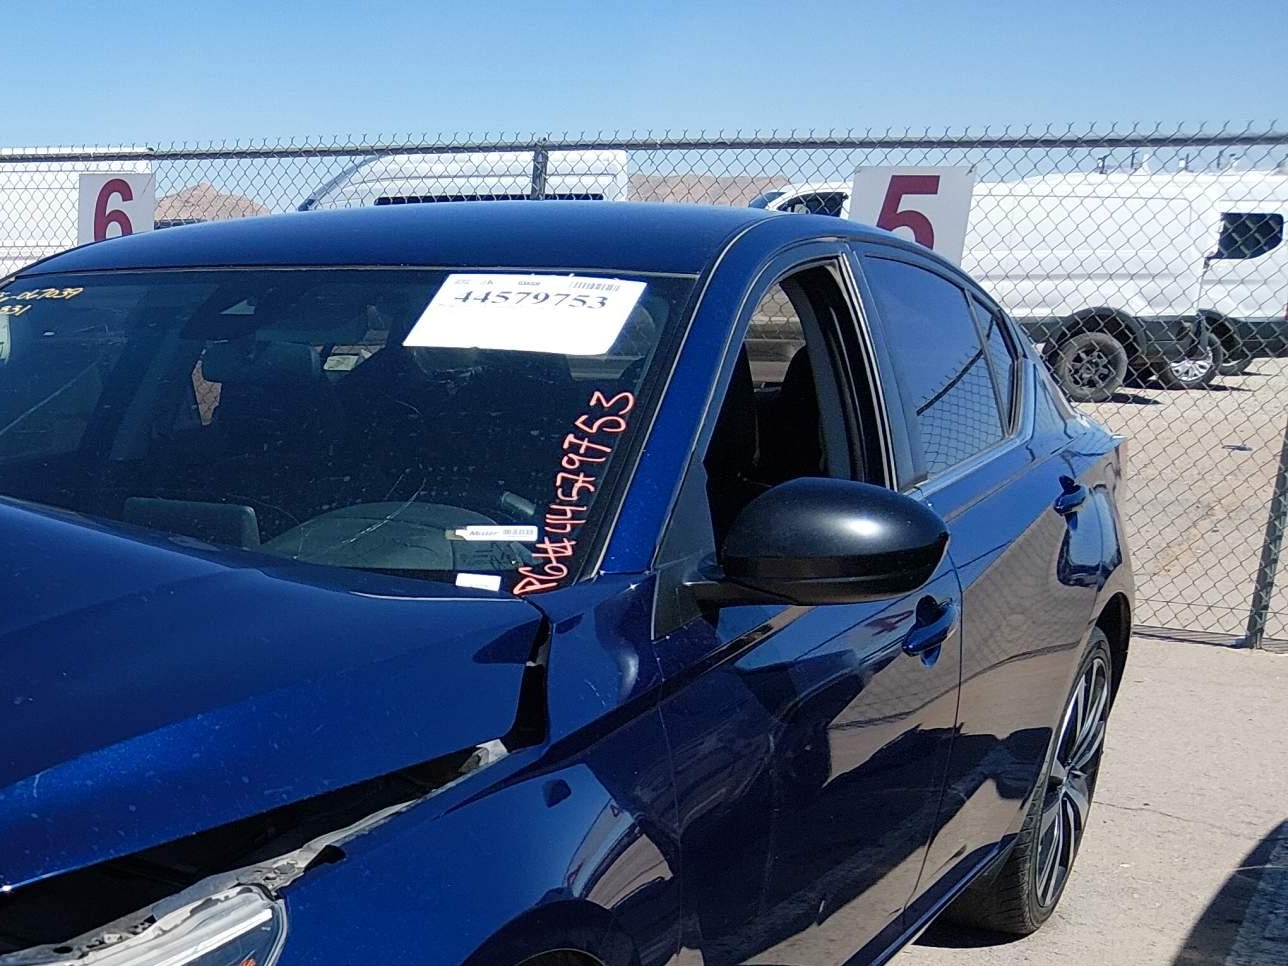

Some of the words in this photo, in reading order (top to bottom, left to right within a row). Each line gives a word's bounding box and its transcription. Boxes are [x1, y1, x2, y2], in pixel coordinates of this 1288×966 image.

[94, 178, 133, 241] 6
[876, 175, 940, 250] 5
[453, 290, 609, 310] 44579753
